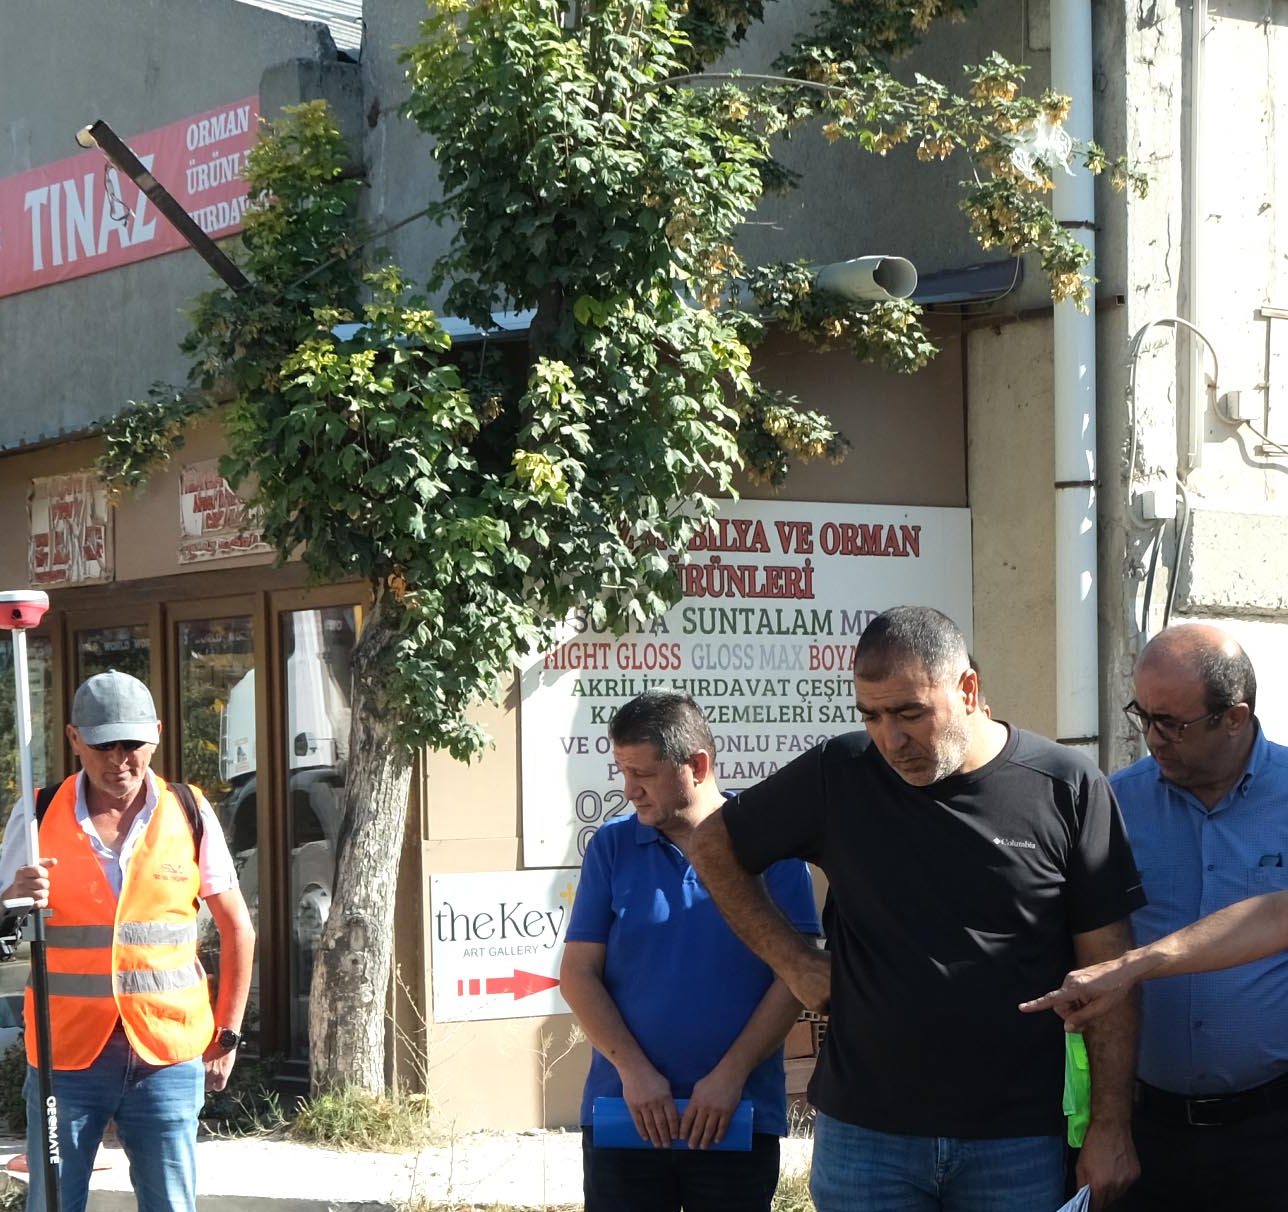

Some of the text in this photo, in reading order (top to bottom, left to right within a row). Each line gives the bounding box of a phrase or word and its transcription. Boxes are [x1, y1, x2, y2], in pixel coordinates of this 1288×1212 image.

[186, 105, 250, 152] ORMAN
[24, 153, 157, 272] TINAZ
[775, 520, 814, 555] VE
[819, 522, 921, 558] ORMAN
[682, 606, 834, 636] SUNTALAM
[543, 643, 611, 671] HIGHT
[616, 642, 682, 671] GLOSS
[691, 643, 755, 671] GLOSS
[760, 644, 804, 671] MAX
[672, 678, 791, 699] HIRDAVAT
[796, 675, 855, 702] ÇEŞİT
[703, 701, 813, 724] ZEMELERİ
[818, 705, 865, 723] SAT
[560, 735, 590, 754] VE
[775, 734, 829, 753] FASO
[1000, 838, 1036, 849] Columbia
[463, 945, 540, 958] ART GALLERY
